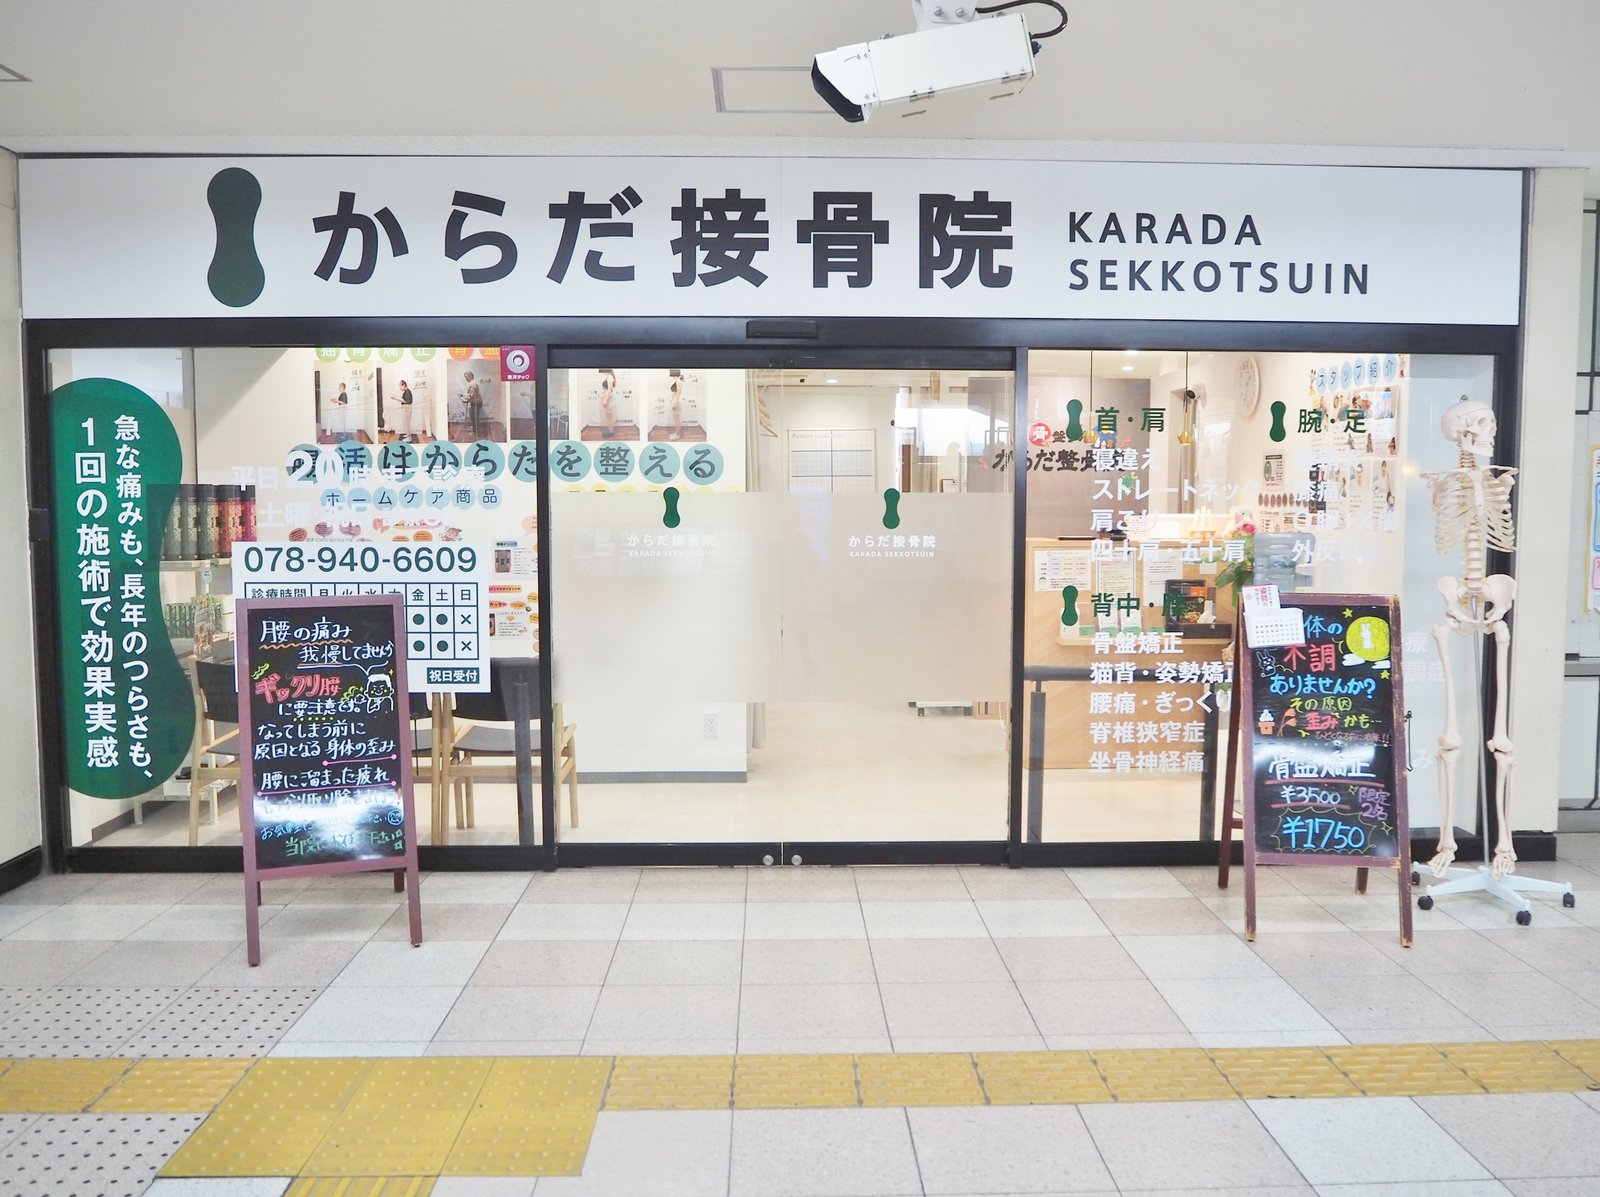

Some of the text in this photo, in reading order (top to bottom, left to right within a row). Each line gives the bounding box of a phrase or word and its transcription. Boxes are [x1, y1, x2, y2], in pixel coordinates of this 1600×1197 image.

[312, 186, 1013, 290] からだ接骨院
[1069, 211, 1262, 246] KARADA
[1069, 258, 1369, 295] SEKKOTSUIN
[1318, 360, 1394, 388] スタッフ紹介
[1095, 407, 1166, 433] 首・肩
[1297, 408, 1367, 434] 腕・足
[325, 487, 498, 507] ホームケア商品
[1092, 478, 1261, 502] ストレートネック
[848, 534, 936, 549] からだ接骨院
[849, 550, 935, 558] KARADA SEKKOTSUIN
[1090, 538, 1246, 563] 四十肩・五十肩
[244, 546, 477, 573] 078-940-6609
[74, 416, 120, 770] 1回の施術で効果実感
[113, 414, 153, 781] 急な痛みも、長年のつらさも、
[411, 588, 425, 601] 金
[435, 588, 449, 601] 土
[460, 588, 471, 601] 日
[260, 616, 353, 643] 腰の痛み
[1090, 631, 1185, 655] 骨盤矯正
[1282, 643, 1337, 673] 不調
[255, 672, 342, 704] ギックリ腰
[429, 669, 478, 682] 祝日受付
[1269, 673, 1376, 699] ありませんか?
[1290, 696, 1352, 713] その原因
[257, 719, 367, 740] なってしまう前に
[1090, 721, 1206, 744] 脊椎狭窄症
[1090, 751, 1205, 774] 坐骨神経痛
[260, 764, 391, 791] 腰に溜まった疲れ
[1280, 784, 1341, 804] ¥3500
[1358, 787, 1392, 806] 限定
[1361, 803, 1389, 821] 2名
[1282, 815, 1365, 849] ¥1750
